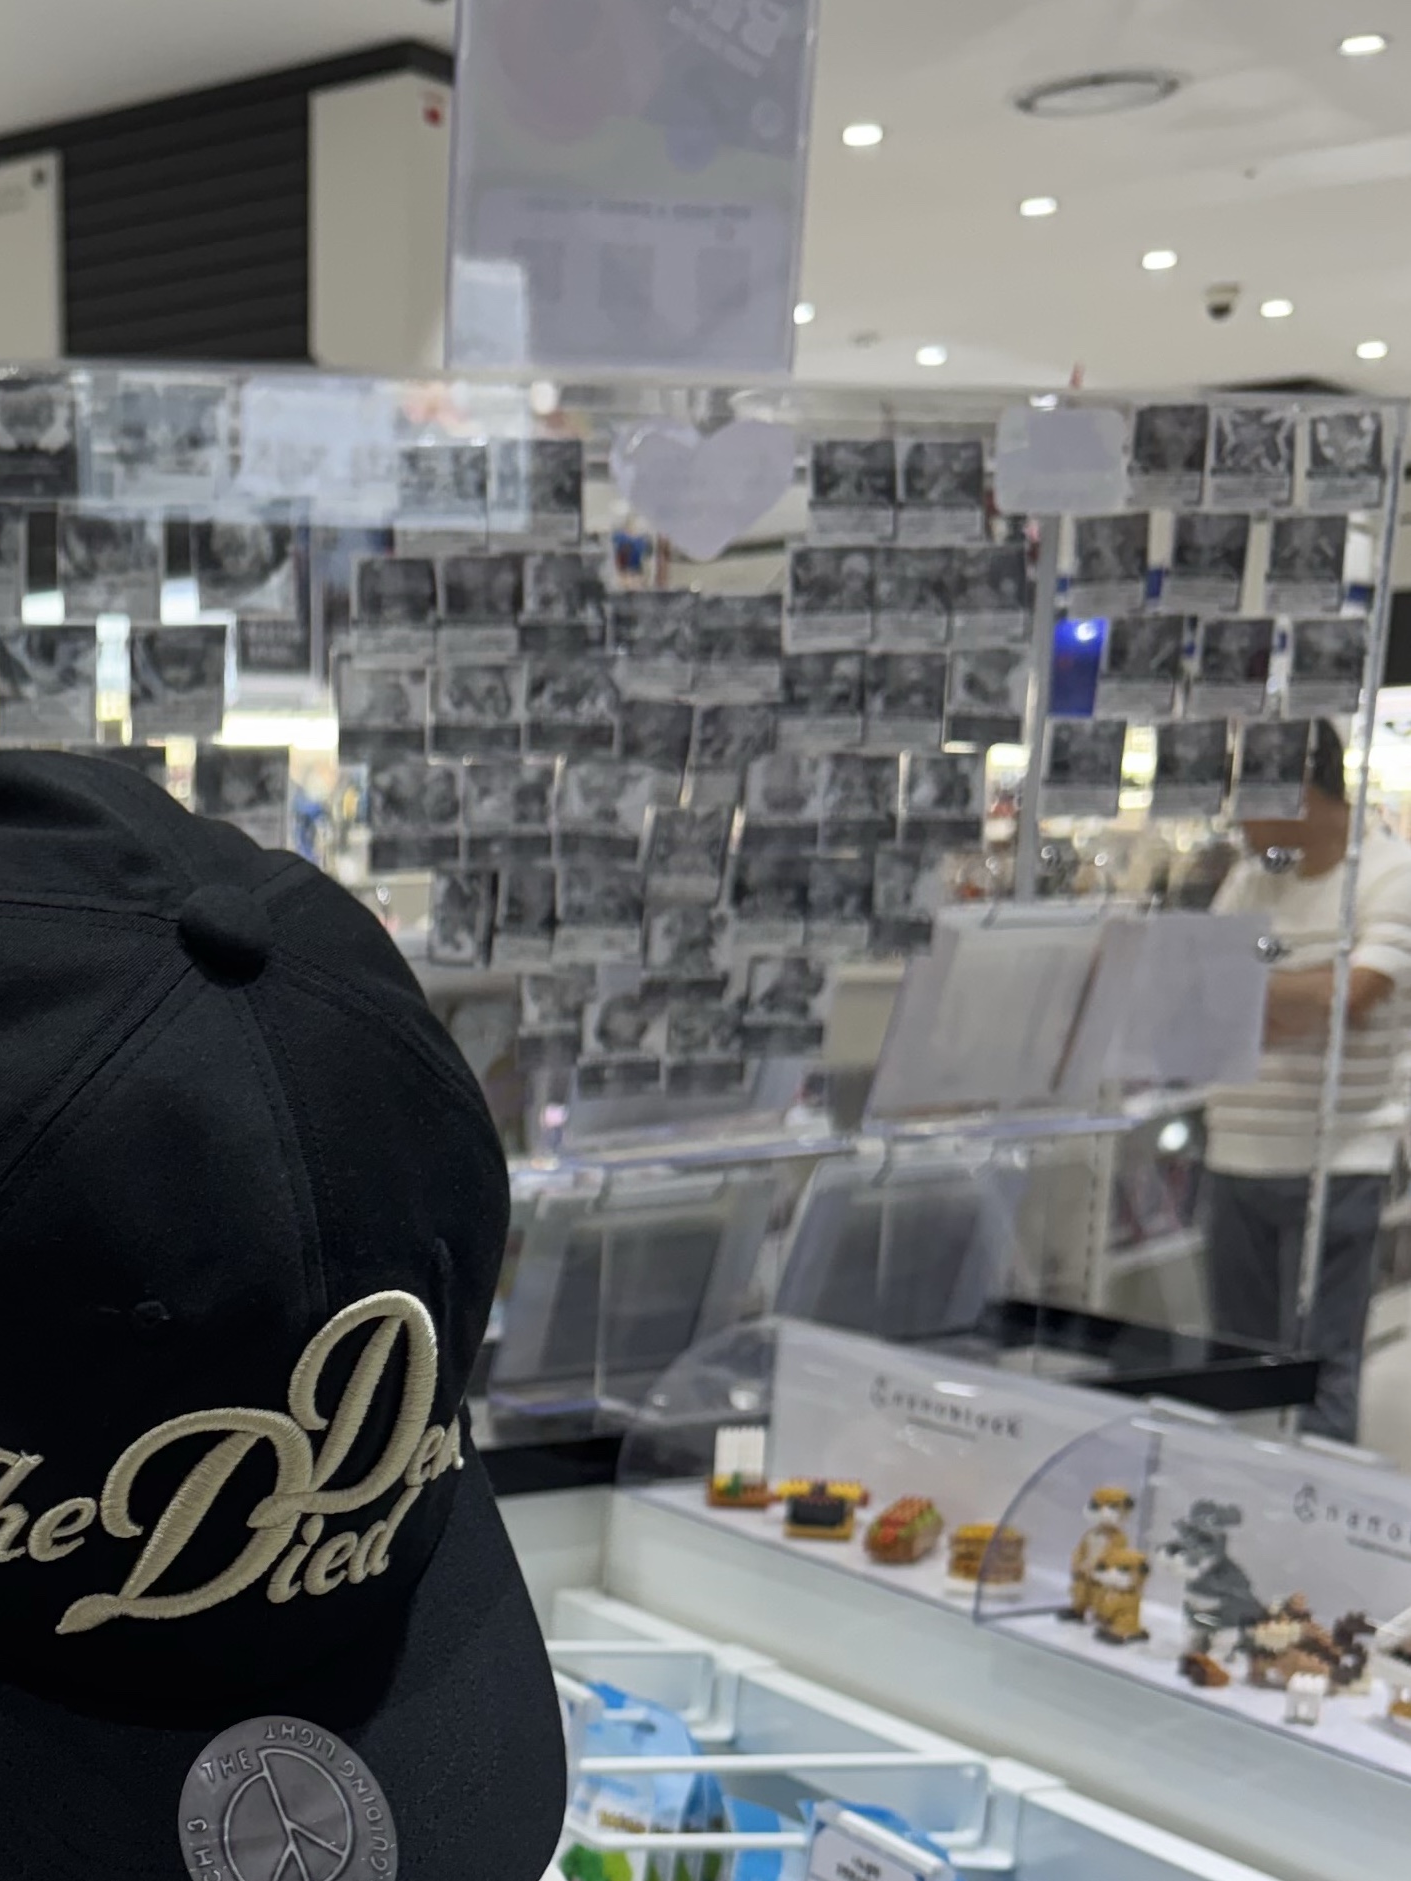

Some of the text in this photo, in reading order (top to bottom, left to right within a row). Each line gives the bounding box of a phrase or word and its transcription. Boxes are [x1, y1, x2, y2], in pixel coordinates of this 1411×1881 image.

[55, 1407, 423, 1634] Died
[1326, 1504, 1411, 1546] nano
[201, 1749, 253, 1782] THE
[264, 1723, 389, 1871] GUIDING LIGHT
